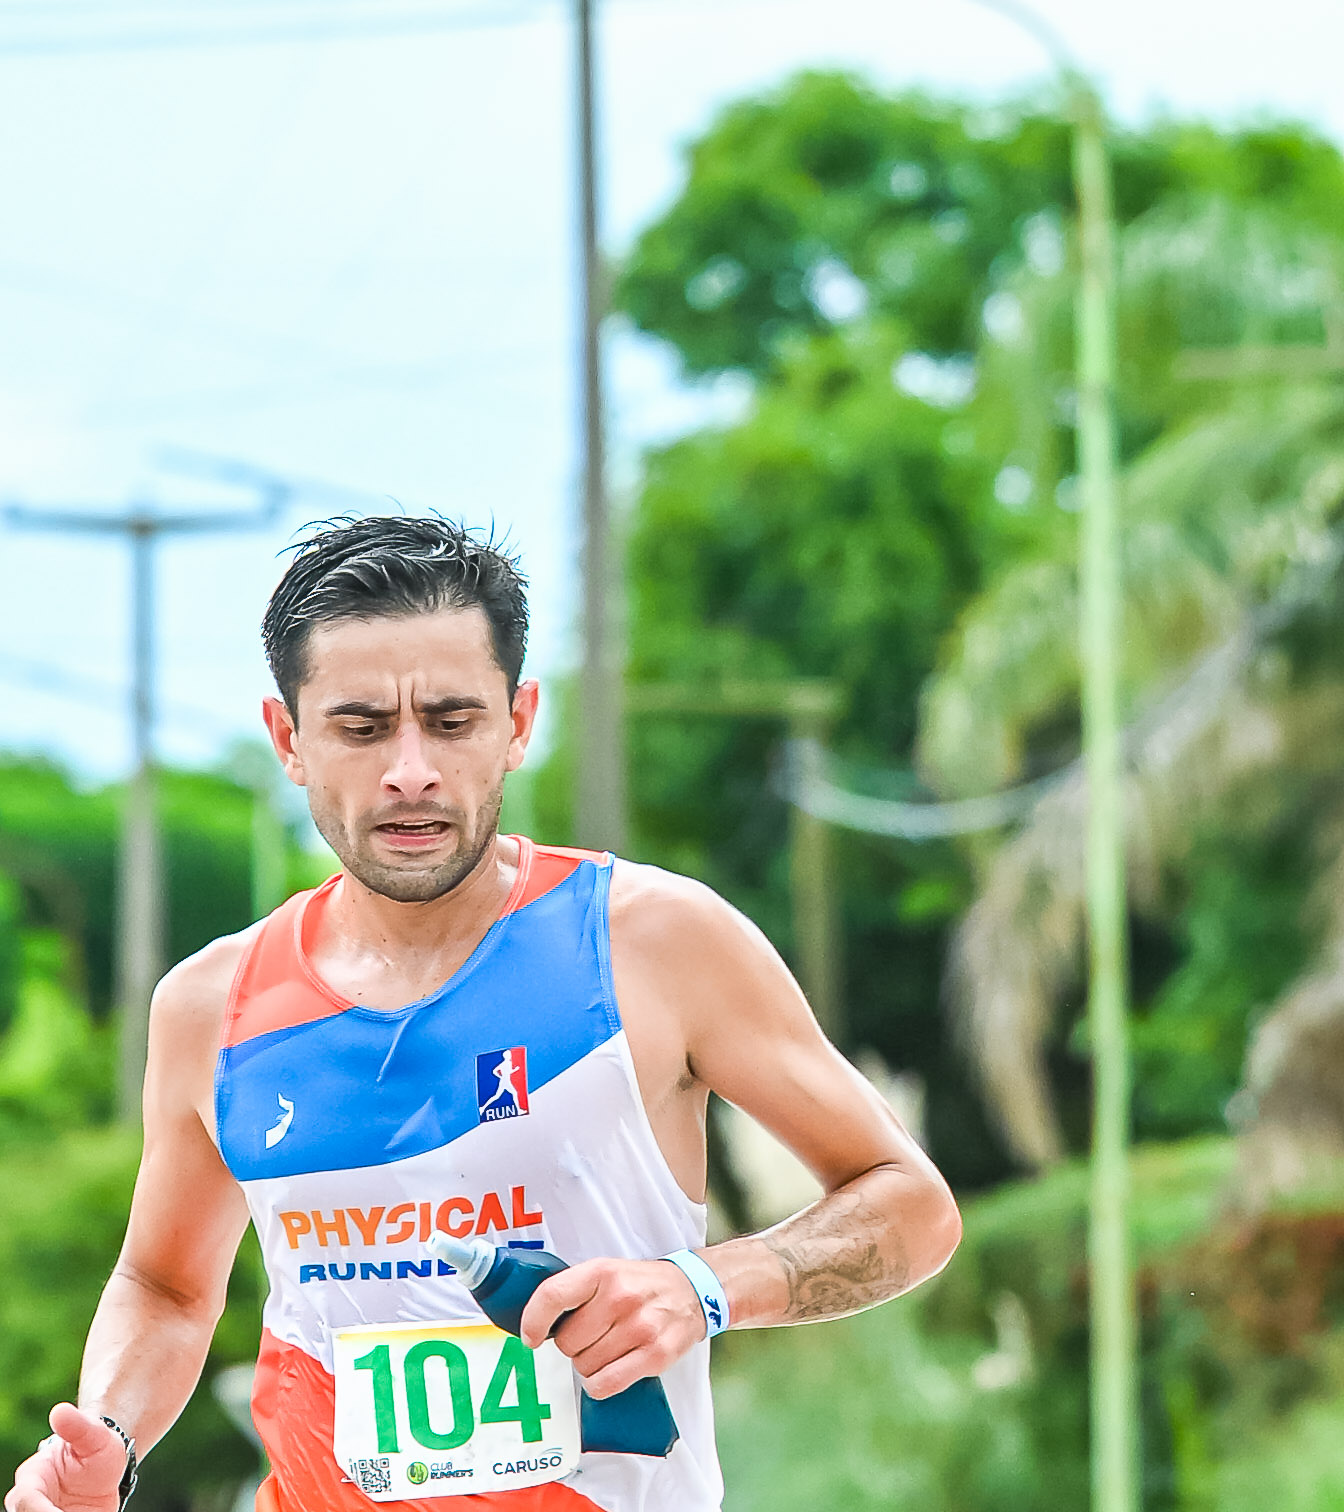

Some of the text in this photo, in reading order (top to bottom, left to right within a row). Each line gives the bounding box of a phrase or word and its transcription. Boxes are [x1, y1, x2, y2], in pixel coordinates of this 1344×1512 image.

[485, 1104, 516, 1121] RUN
[279, 1185, 543, 1250] PHYSICAL
[354, 1336, 551, 1454] 104
[430, 1462, 453, 1472] CLUB
[492, 1455, 562, 1475] CARUSO
